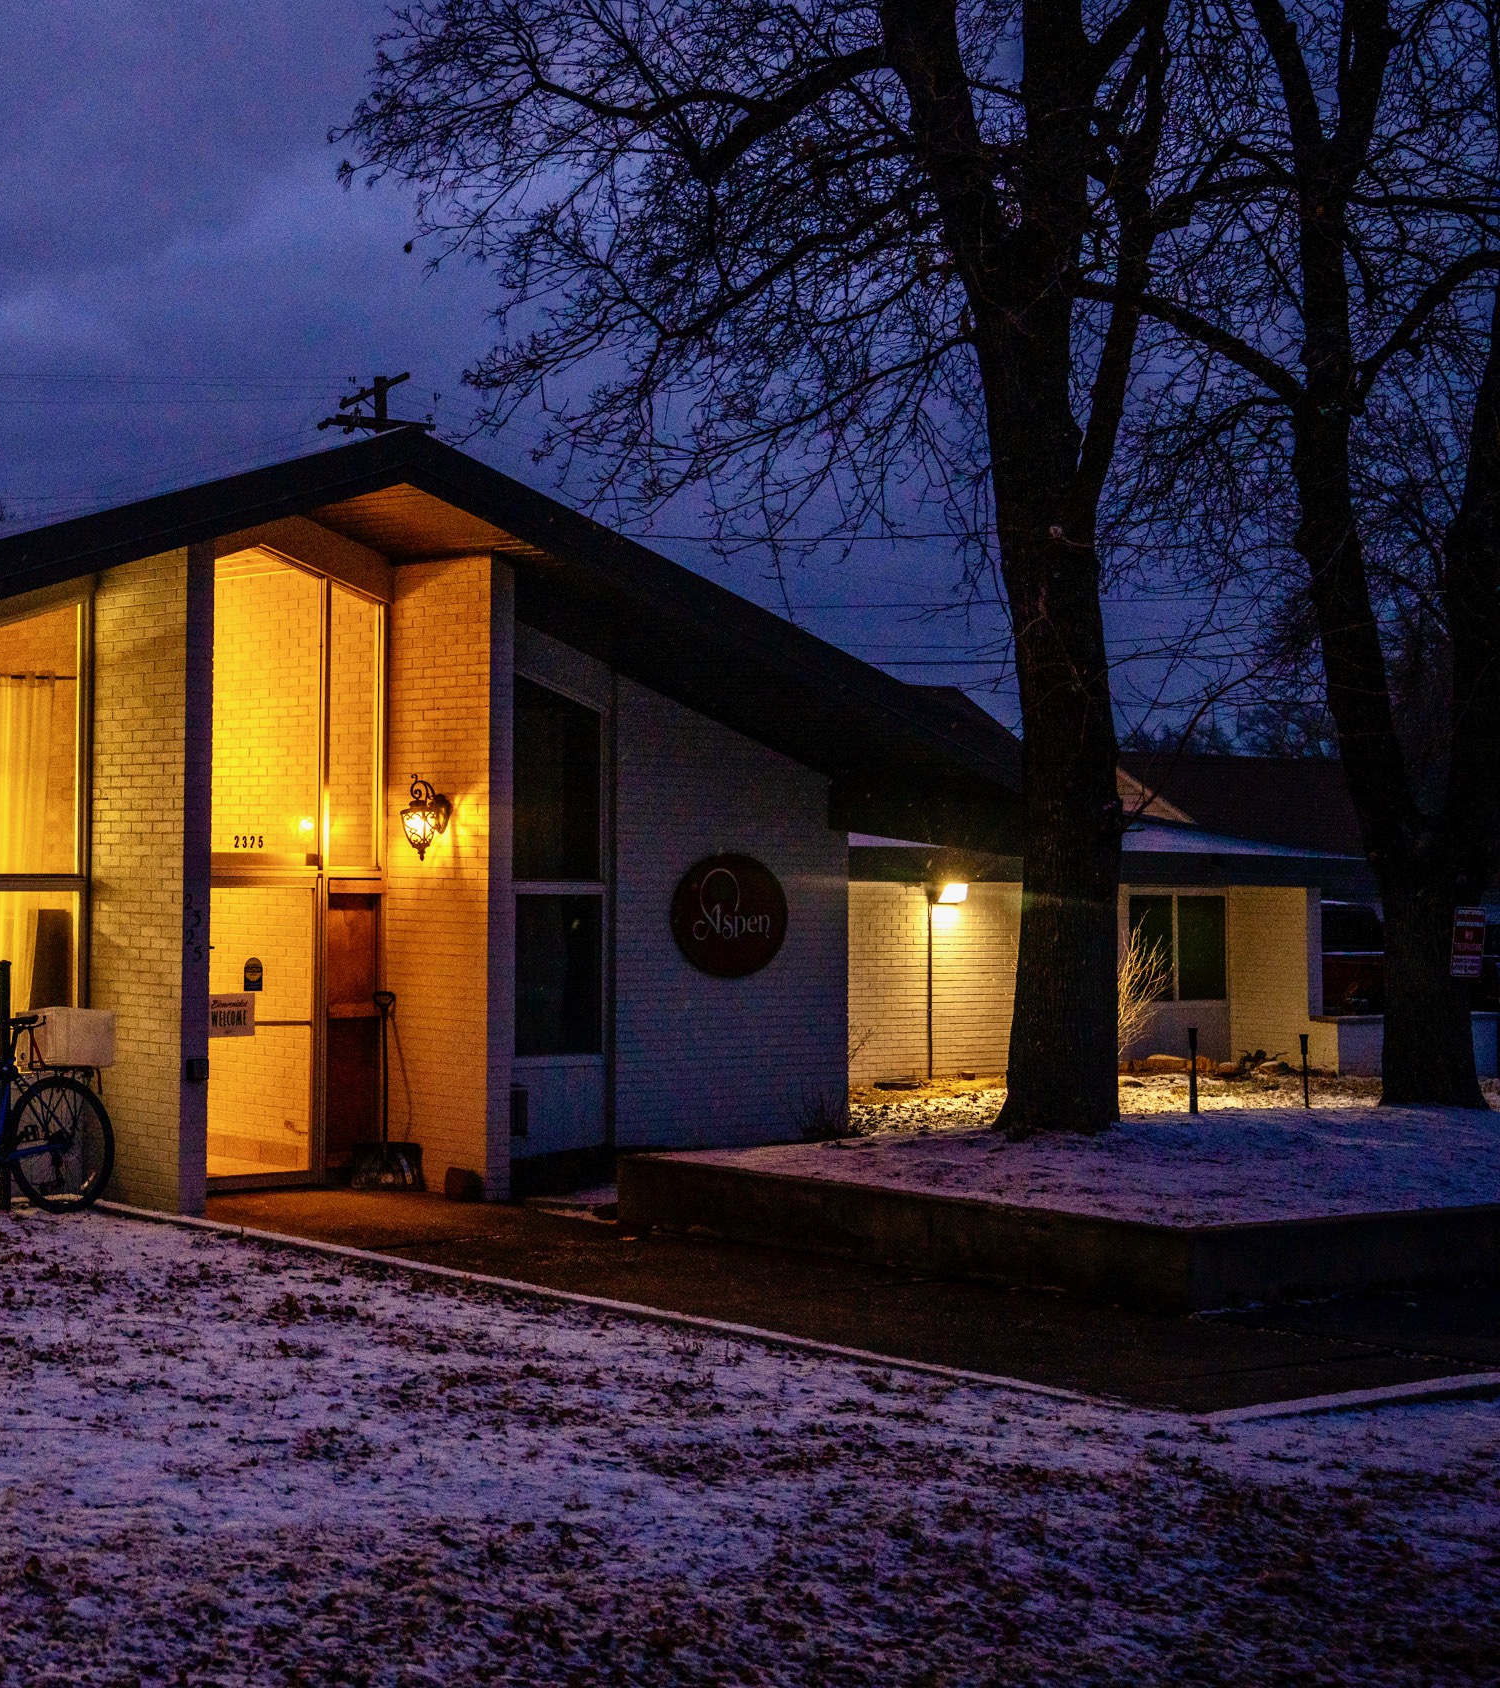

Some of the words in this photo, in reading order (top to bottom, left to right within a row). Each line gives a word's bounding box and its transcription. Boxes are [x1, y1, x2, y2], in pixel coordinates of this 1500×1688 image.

[234, 835, 263, 849] 2325
[692, 868, 771, 941] Aspen
[211, 1009, 247, 1027] WELCOME
